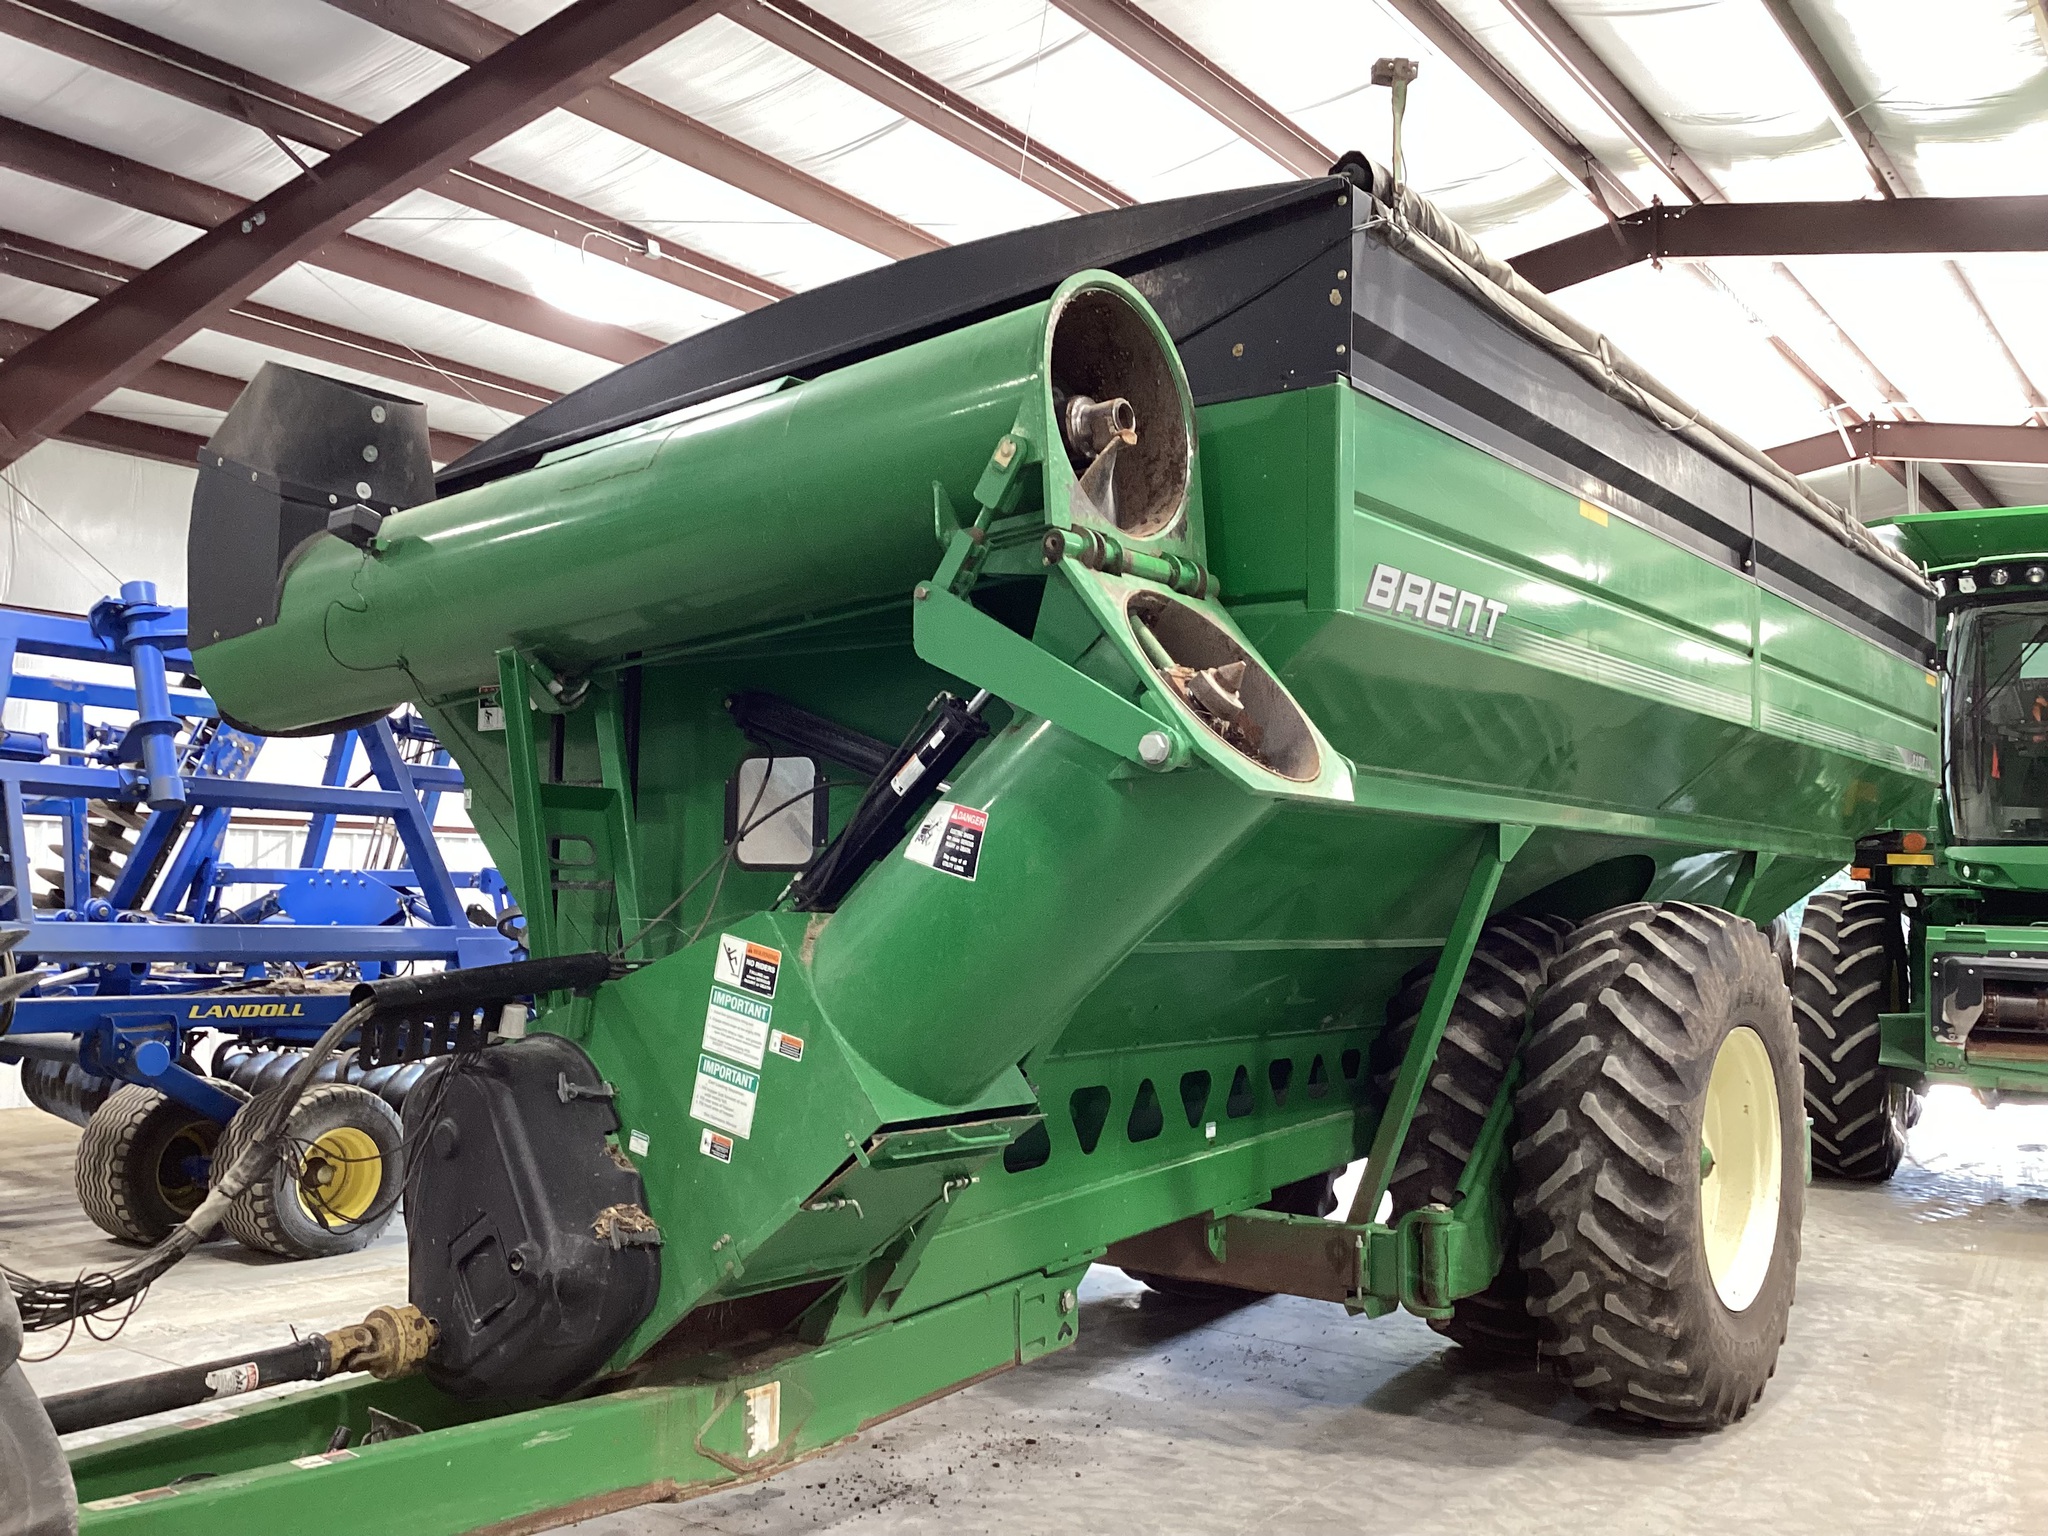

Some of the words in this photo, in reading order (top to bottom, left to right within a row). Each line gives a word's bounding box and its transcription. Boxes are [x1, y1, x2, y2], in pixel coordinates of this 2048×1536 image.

[1363, 563, 1509, 642] BRENT
[958, 811, 986, 828] DANGER
[188, 1003, 305, 1019] LANDOLL
[713, 990, 768, 1019] IMPORTANT
[702, 1059, 754, 1089] IMPORTANT
